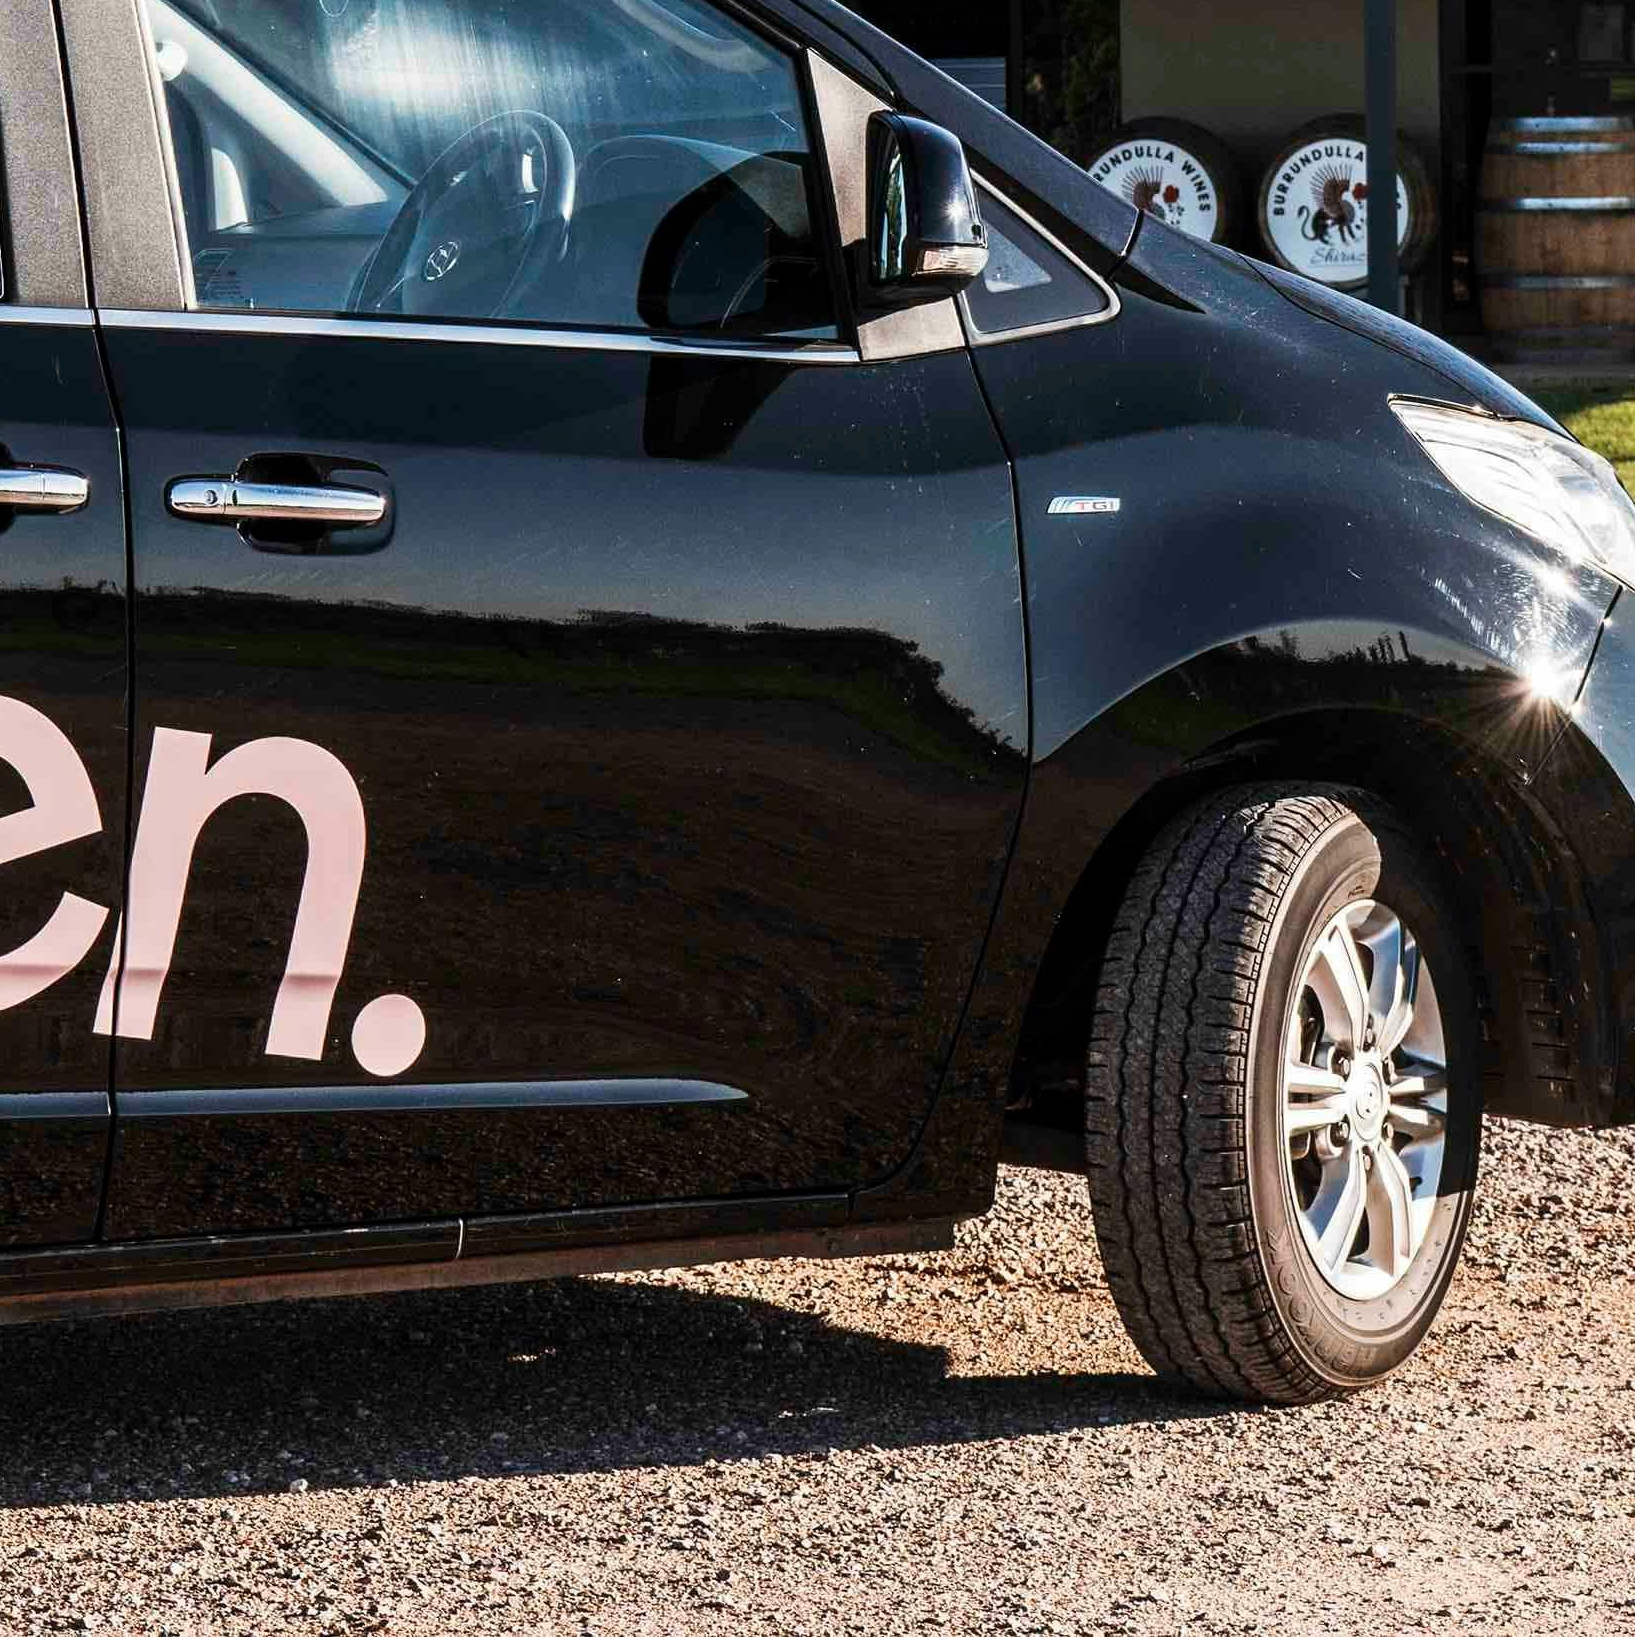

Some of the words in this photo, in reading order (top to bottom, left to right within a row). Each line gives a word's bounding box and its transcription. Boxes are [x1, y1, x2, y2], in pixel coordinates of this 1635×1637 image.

[1093, 145, 1175, 183] RUNDULLA
[1181, 159, 1211, 212] WINES
[1273, 145, 1365, 216] BURRUNDULLA
